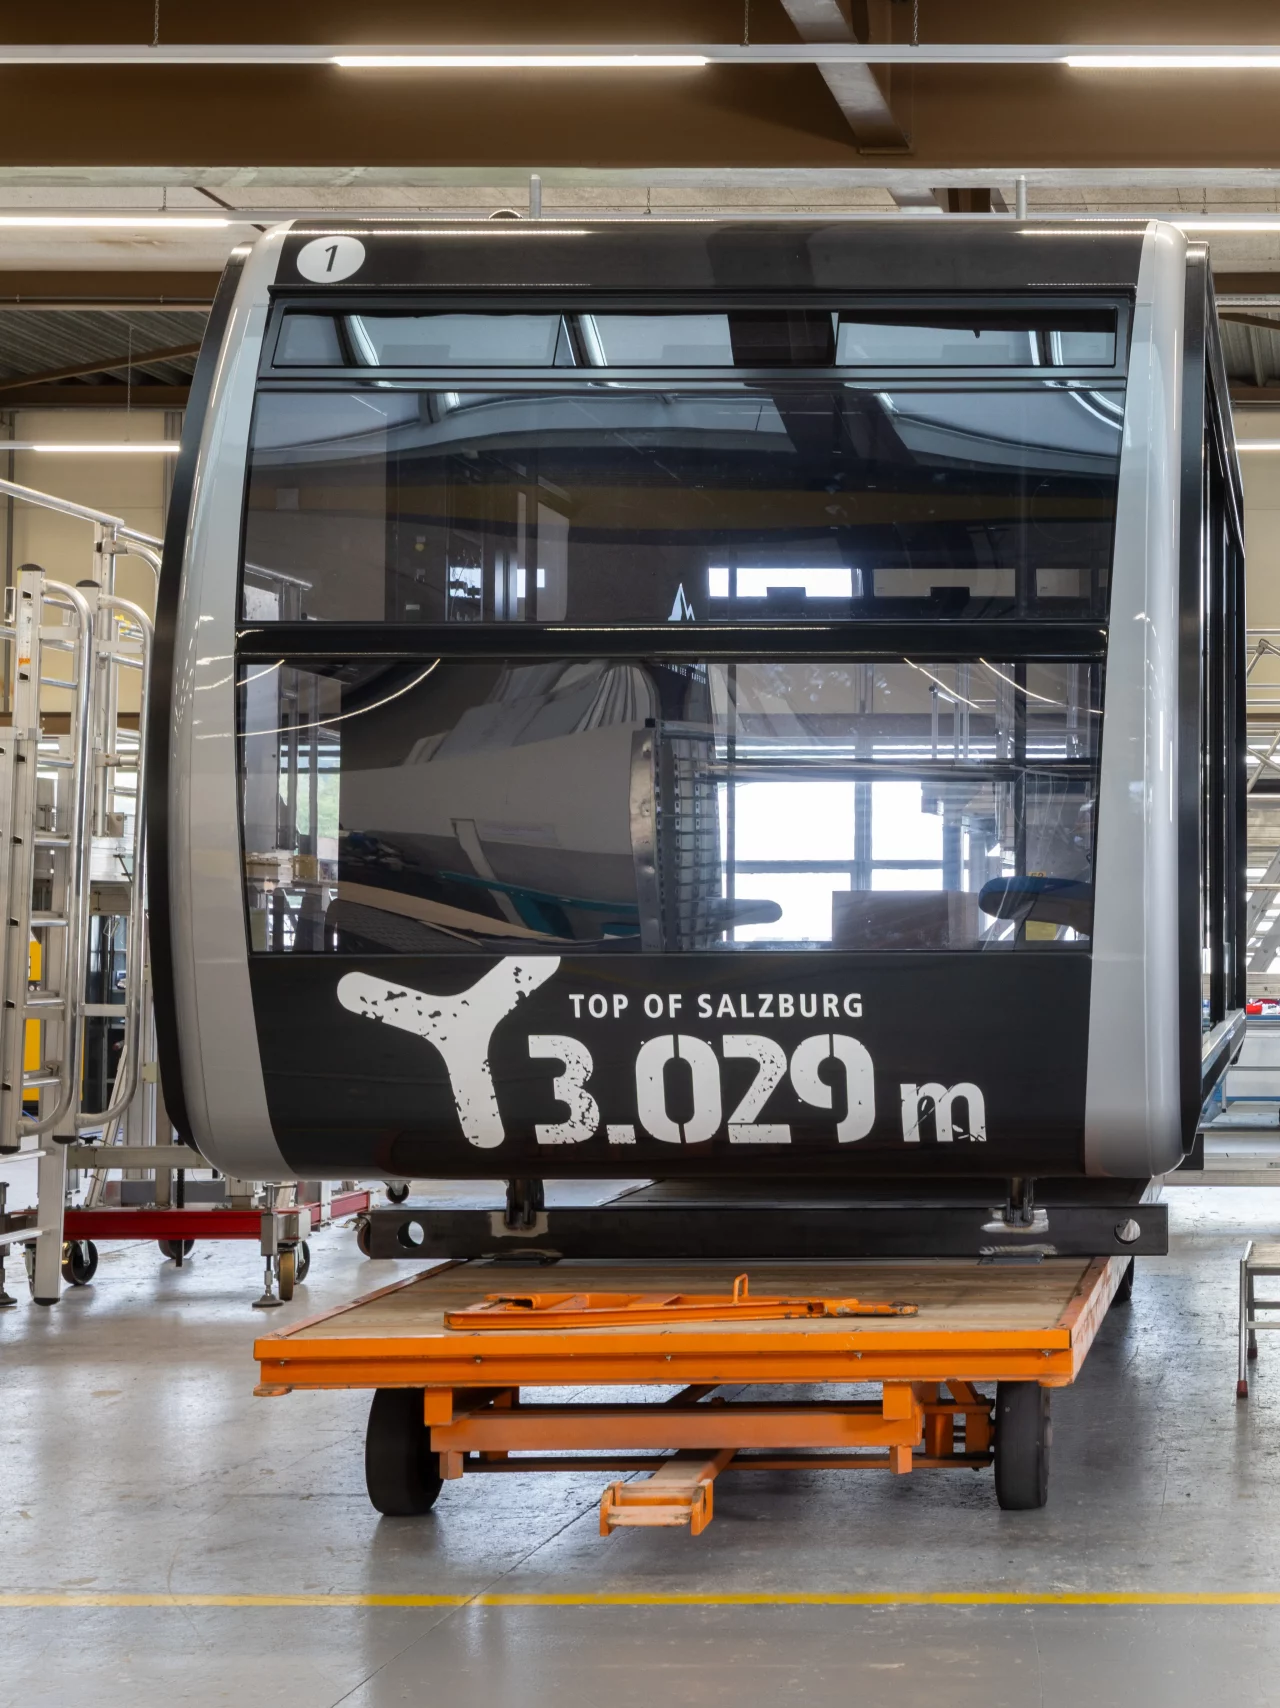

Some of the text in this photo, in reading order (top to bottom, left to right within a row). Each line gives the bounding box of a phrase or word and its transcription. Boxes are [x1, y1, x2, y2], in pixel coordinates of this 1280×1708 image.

[325, 245, 338, 272] 1
[569, 993, 863, 1018] TOP OF SALZBURG
[527, 1033, 986, 1144] 3.029 m
